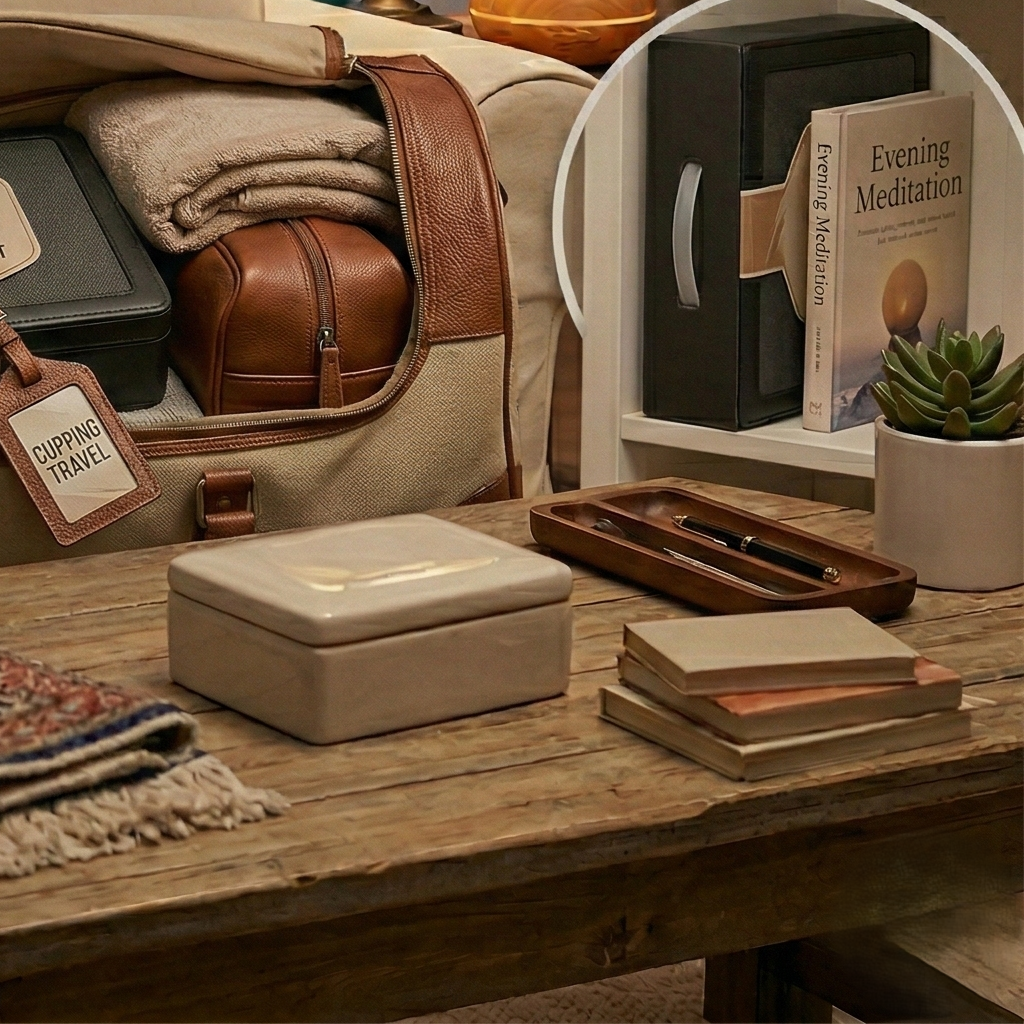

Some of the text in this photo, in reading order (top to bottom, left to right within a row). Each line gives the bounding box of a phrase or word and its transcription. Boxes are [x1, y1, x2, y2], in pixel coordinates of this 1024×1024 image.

[871, 137, 951, 173] Evening
[854, 172, 963, 214] Meditation
[812, 143, 832, 307] Evening Meditation
[32, 418, 101, 465] CUPPING
[46, 442, 111, 485] TRAVEL
